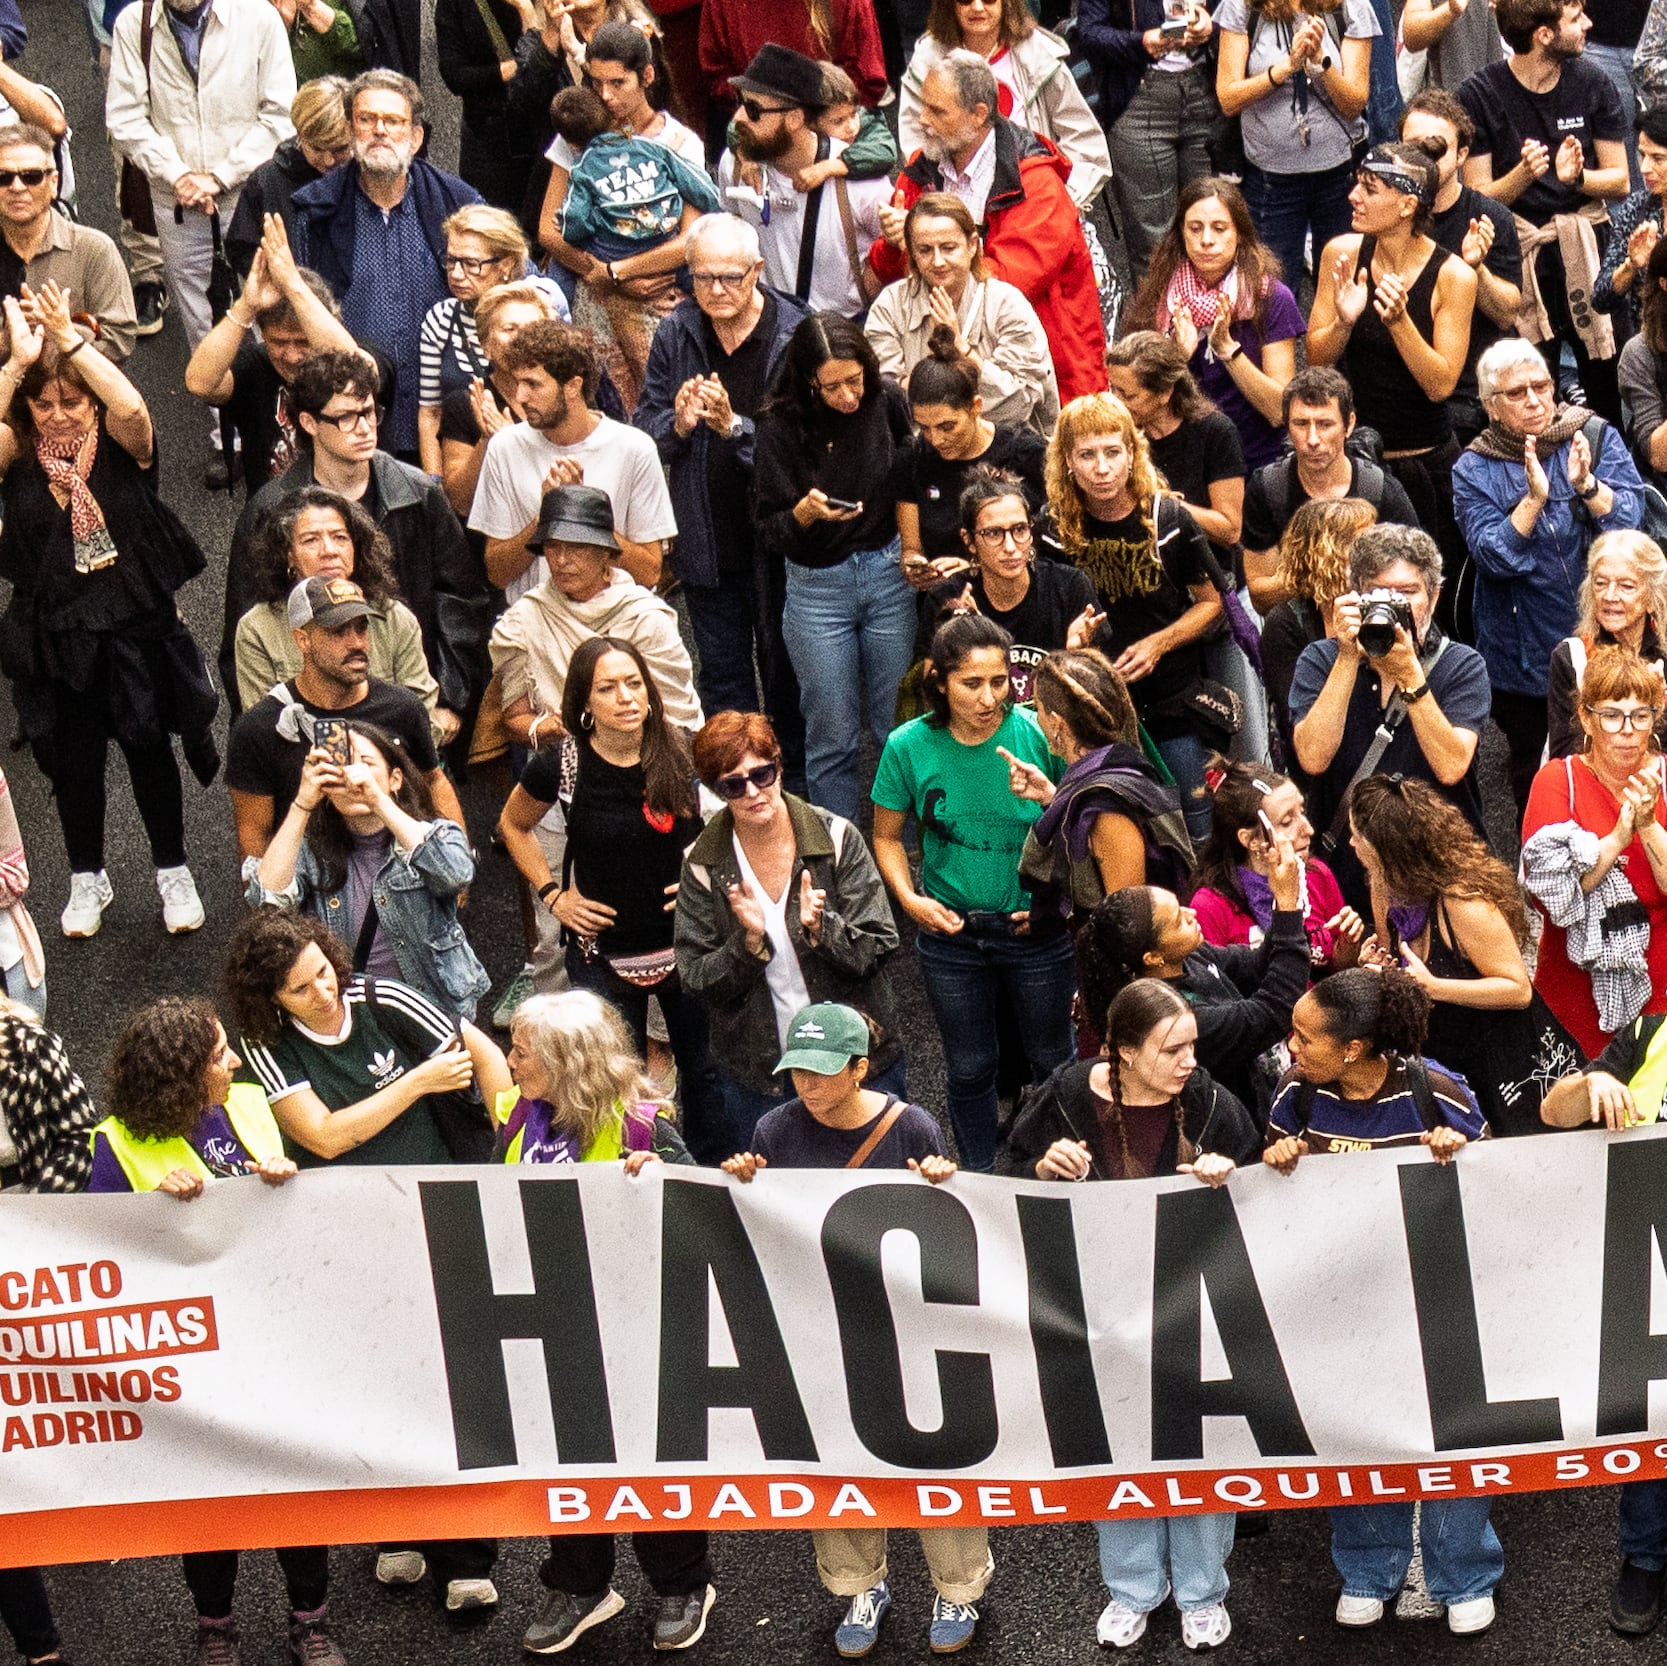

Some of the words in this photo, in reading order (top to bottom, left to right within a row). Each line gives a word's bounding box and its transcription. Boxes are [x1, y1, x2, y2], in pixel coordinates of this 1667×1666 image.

[595, 160, 660, 196] TEAM
[375, 1065, 404, 1089] adidas
[0, 1260, 122, 1311] CATO
[419, 1179, 1316, 1471] HACIA
[0, 1365, 182, 1407] UILINOS
[548, 1482, 880, 1525] BAJADA
[919, 1485, 1067, 1518] DEL
[1108, 1461, 1512, 1509] ALQUILER
